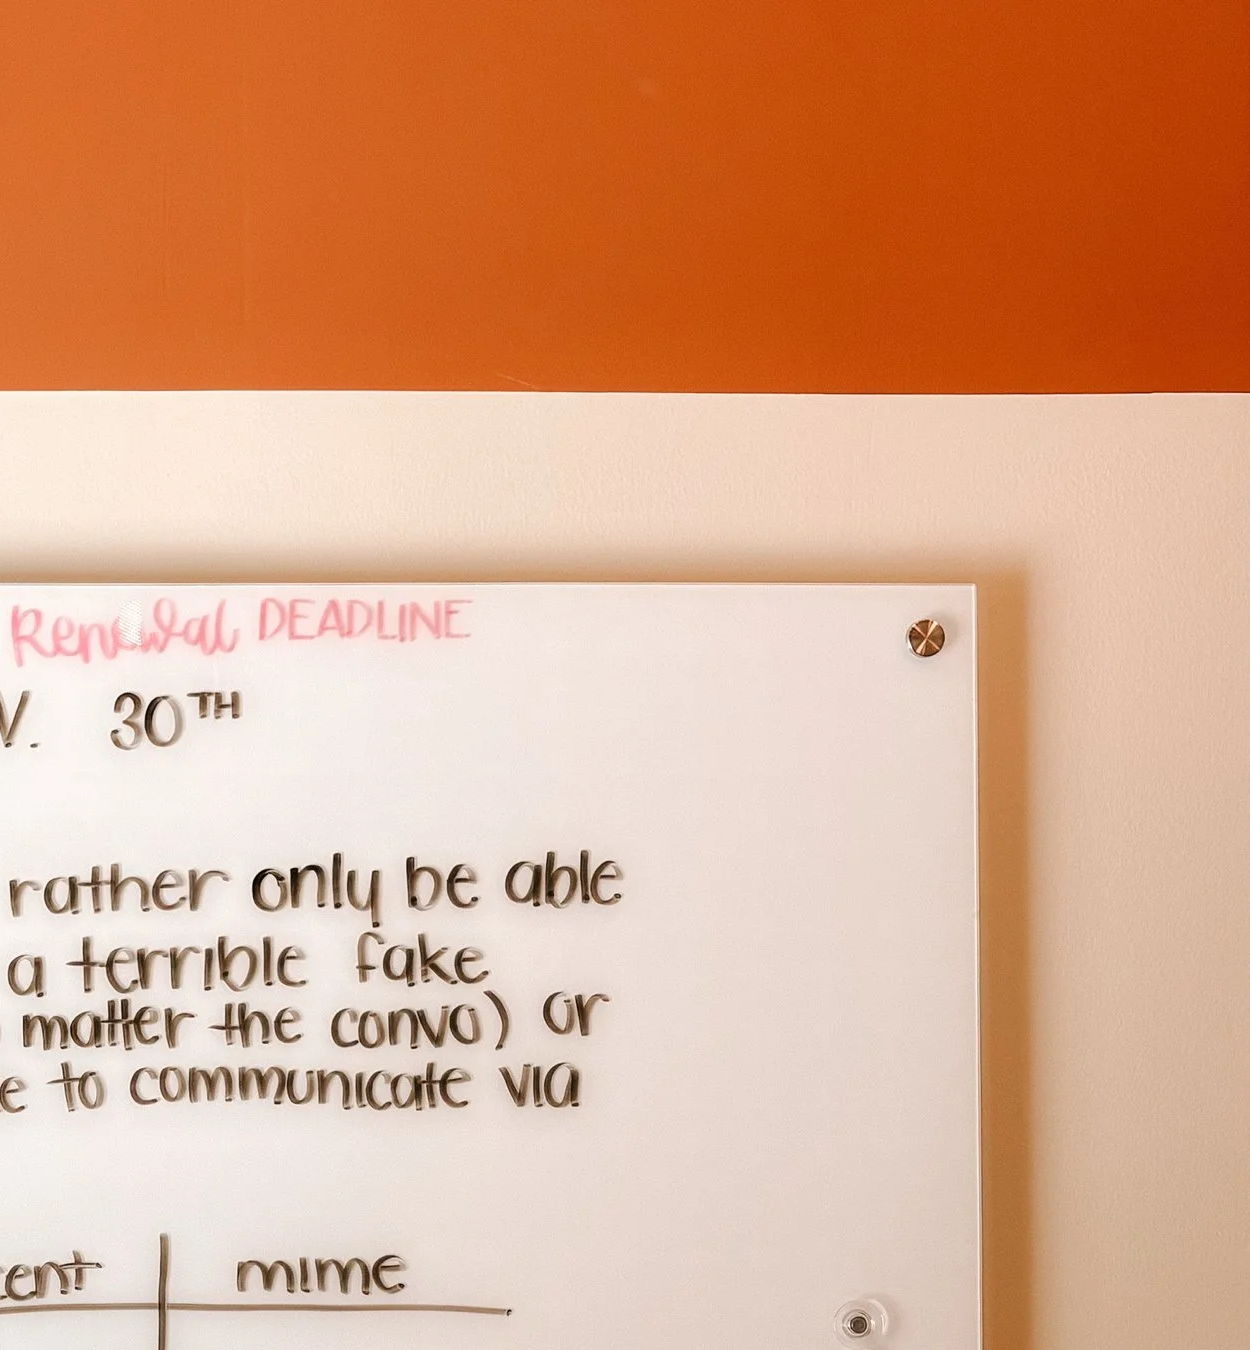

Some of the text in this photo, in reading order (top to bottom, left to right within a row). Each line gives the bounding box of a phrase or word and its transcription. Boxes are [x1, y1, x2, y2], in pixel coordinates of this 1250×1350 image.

[258, 597, 472, 642] DEADLINE
[109, 689, 243, 751] 30TH
[8, 862, 232, 918] rather
[251, 851, 383, 929] only
[405, 855, 482, 912] be
[503, 849, 625, 910] able
[7, 953, 48, 999] a
[65, 935, 309, 995] terrible
[355, 931, 491, 988] fake
[22, 997, 197, 1052] matter
[207, 1001, 305, 1049] the
[330, 989, 511, 1052] convo)
[542, 990, 611, 1037] or
[46, 1061, 106, 1112] to
[129, 1061, 473, 1112] communicate
[498, 1061, 583, 1109] via
[236, 1254, 409, 1297] mime
